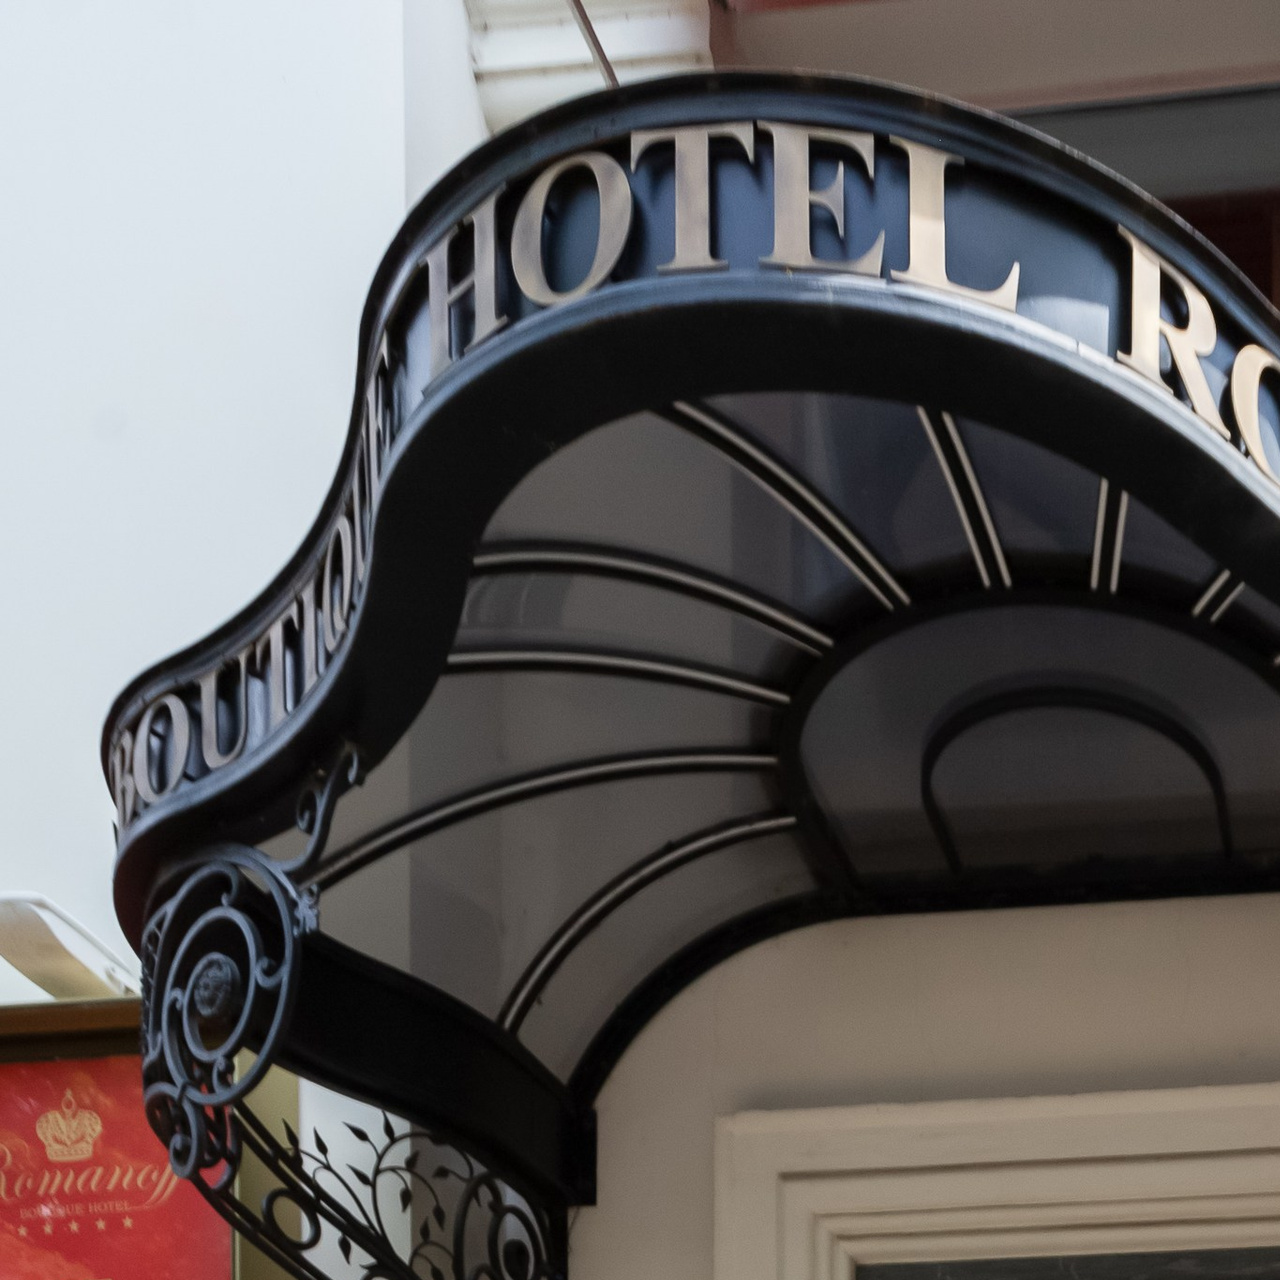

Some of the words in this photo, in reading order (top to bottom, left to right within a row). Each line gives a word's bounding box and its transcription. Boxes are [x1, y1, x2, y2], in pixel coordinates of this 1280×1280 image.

[111, 331, 393, 828] BOUTIQUE
[418, 120, 1020, 398] HOTEL
[88, 1200, 131, 1214] HOTEL
